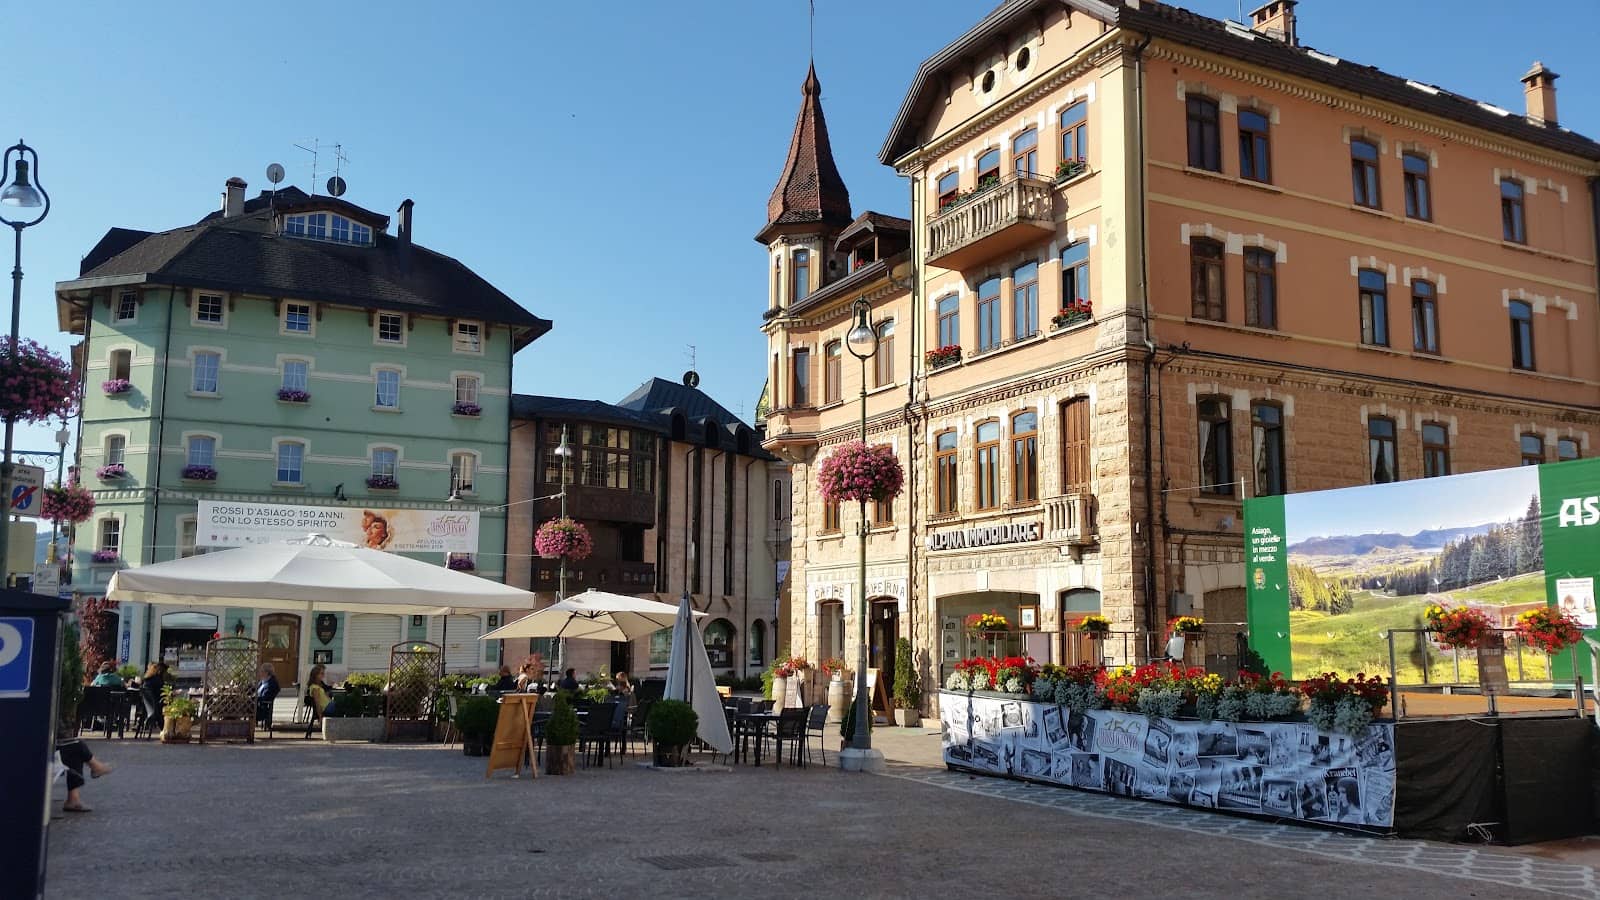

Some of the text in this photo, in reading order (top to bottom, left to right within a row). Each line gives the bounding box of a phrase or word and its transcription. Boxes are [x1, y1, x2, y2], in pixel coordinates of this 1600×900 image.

[211, 506, 245, 516] ROSSI
[299, 509, 317, 519] 150
[211, 515, 337, 528] CON LO STESSO SPIRITO
[1559, 496, 1600, 528] AS
[929, 521, 1038, 551] ALPINA IMMOBILIARE
